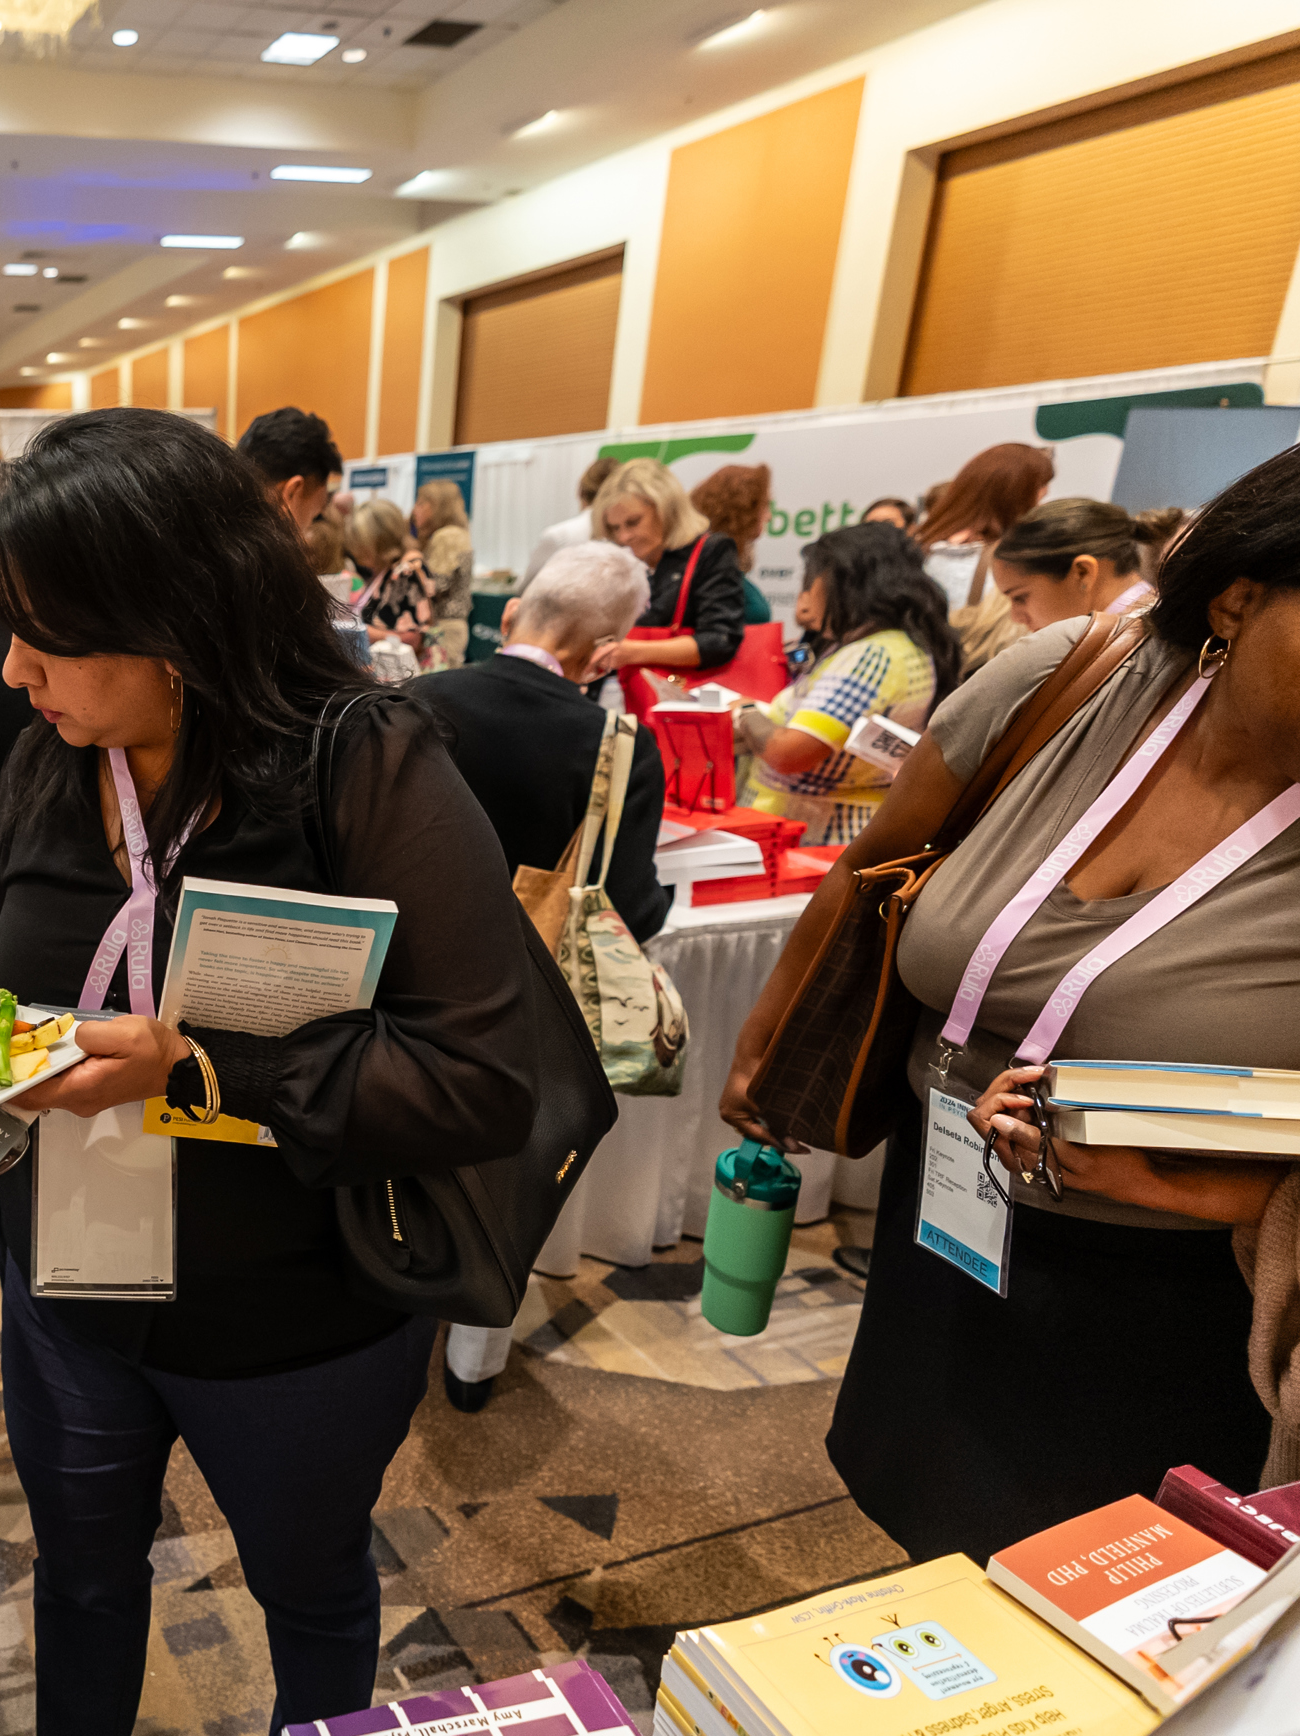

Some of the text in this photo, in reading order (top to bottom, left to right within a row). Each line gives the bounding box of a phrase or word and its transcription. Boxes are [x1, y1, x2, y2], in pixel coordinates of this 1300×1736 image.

[767, 500, 863, 538] bett
[1140, 708, 1183, 757] Rula
[126, 811, 143, 851] Rula
[1036, 841, 1081, 883] Rula
[1193, 843, 1250, 891] Rula
[94, 928, 128, 975] Rula
[131, 941, 150, 990] Rula
[960, 960, 991, 1001] Rula
[1064, 956, 1108, 999] Rula
[933, 1122, 1001, 1164] Delseta Robinon
[926, 1230, 988, 1278] ATTENDEE
[1225, 1496, 1300, 1543] BJECT
[1046, 1523, 1174, 1587] MANFIELD, PHD
[1104, 1552, 1163, 1586] PHILIP
[790, 1581, 905, 1624] Christine Mark-Griffin, LCSW
[1122, 1571, 1245, 1640] SUBTLETIES OF TRAUMA
[1131, 1572, 1201, 1612] PROCESSING
[969, 1693, 1013, 1724] Anger,
[1005, 1681, 1055, 1712] Stress,
[413, 1707, 522, 1736] Amy Marschall,
[1006, 1703, 1066, 1736] Help Kids
